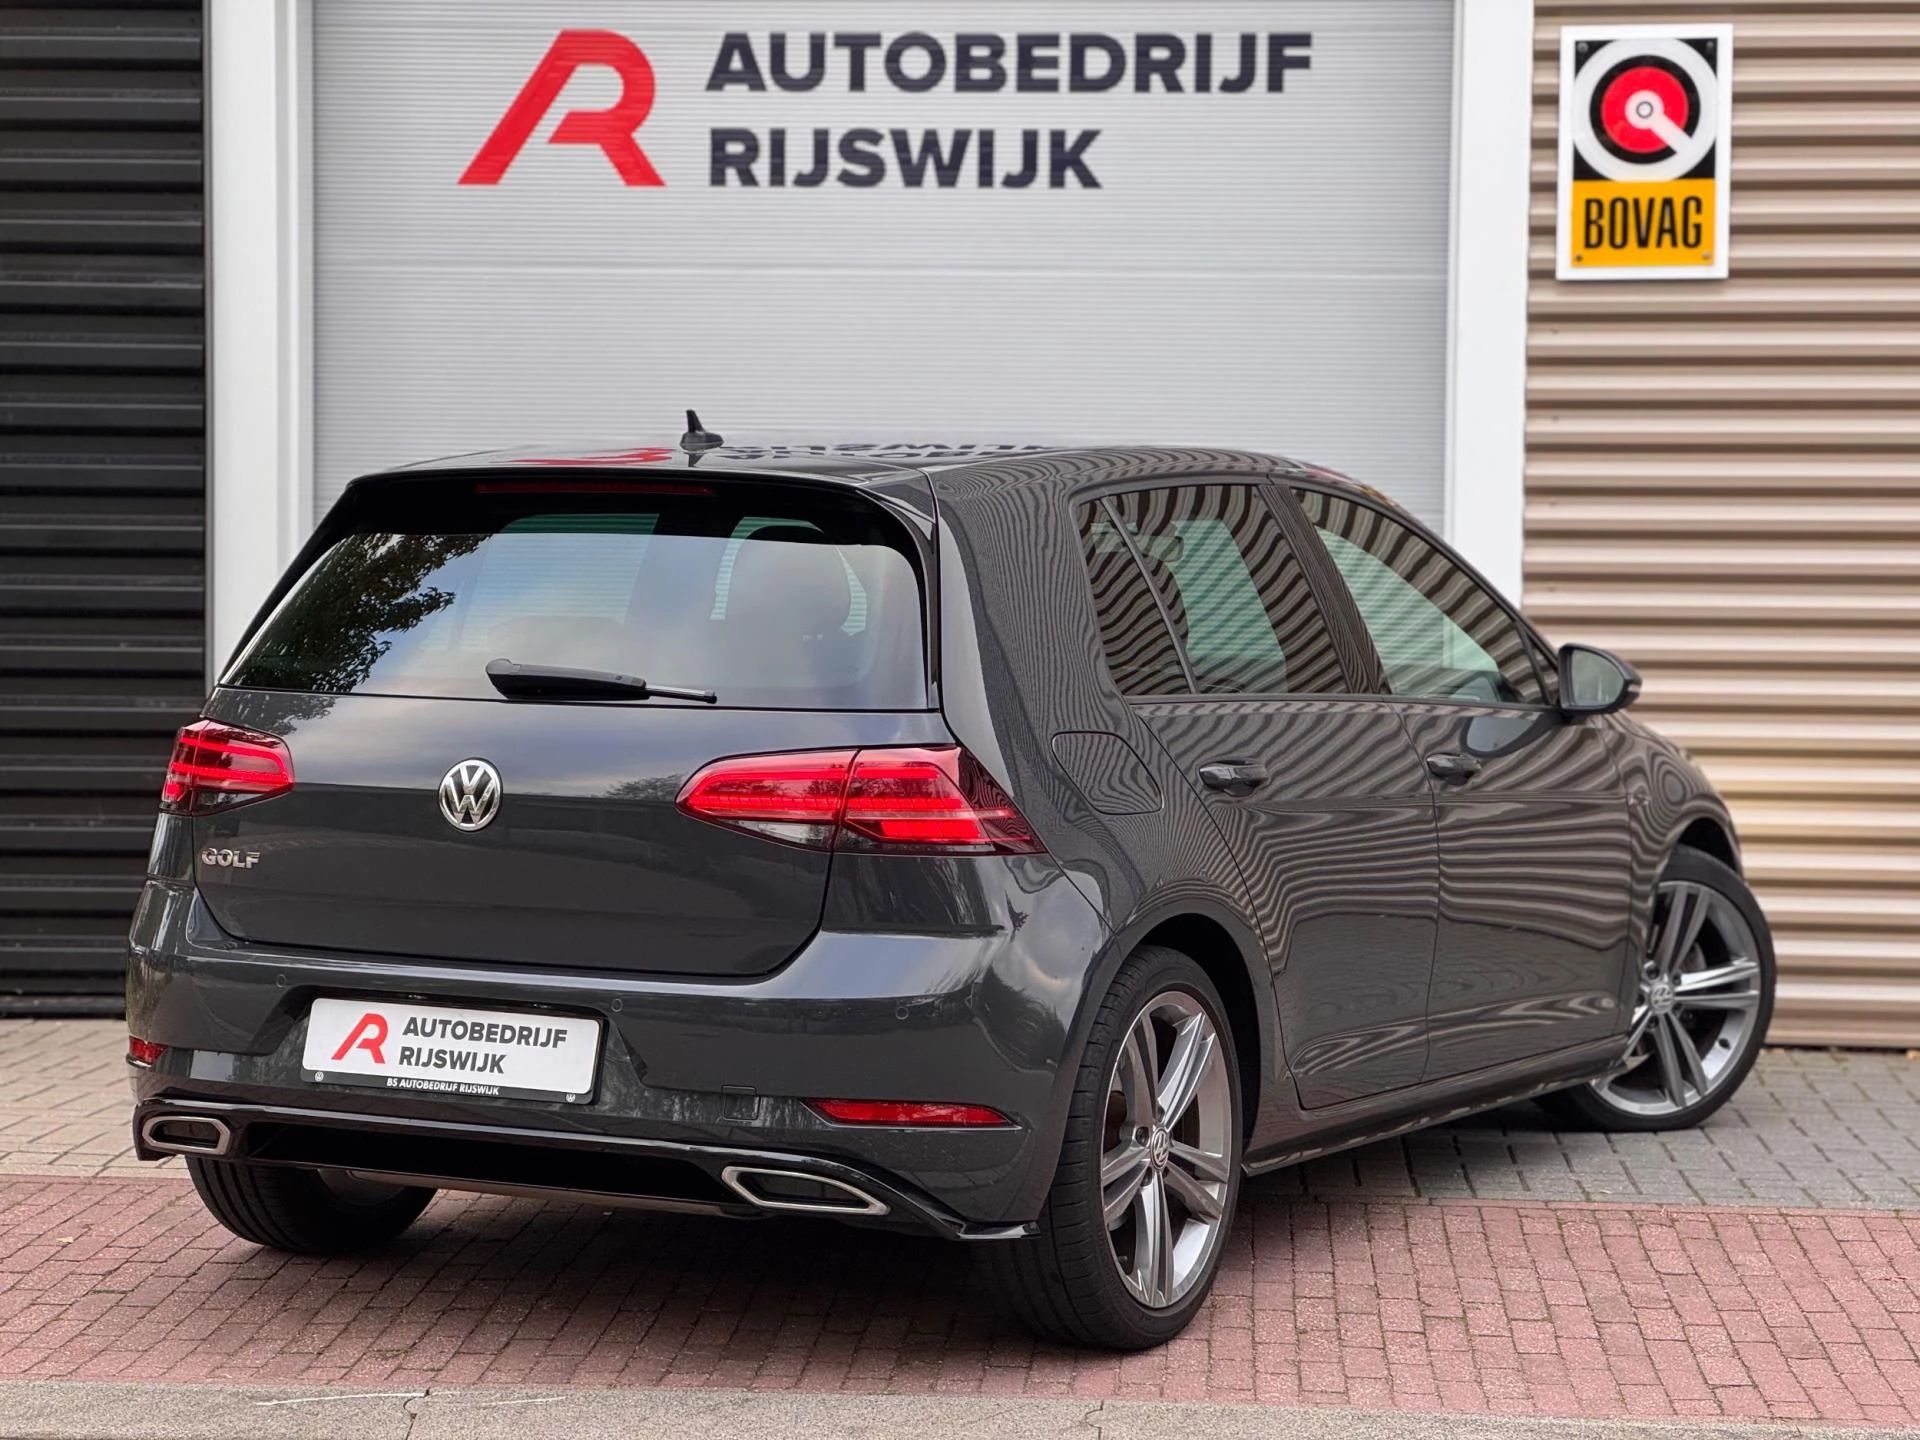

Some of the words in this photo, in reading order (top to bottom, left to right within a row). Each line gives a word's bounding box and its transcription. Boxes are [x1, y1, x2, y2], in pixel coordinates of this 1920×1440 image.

[706, 32, 1313, 94] AUTOBEDRIJF
[709, 128, 1103, 189] RIJSWIJK
[1583, 196, 1702, 250] BOVAG
[201, 848, 261, 869] GOLF
[403, 1016, 568, 1048] AUTOBEDRIJF
[398, 1046, 506, 1074] RIJSWIJK
[386, 1078, 398, 1087] BS
[399, 1078, 458, 1092] AUTOBEDRIJF
[459, 1083, 500, 1096] RIJSWIJK
